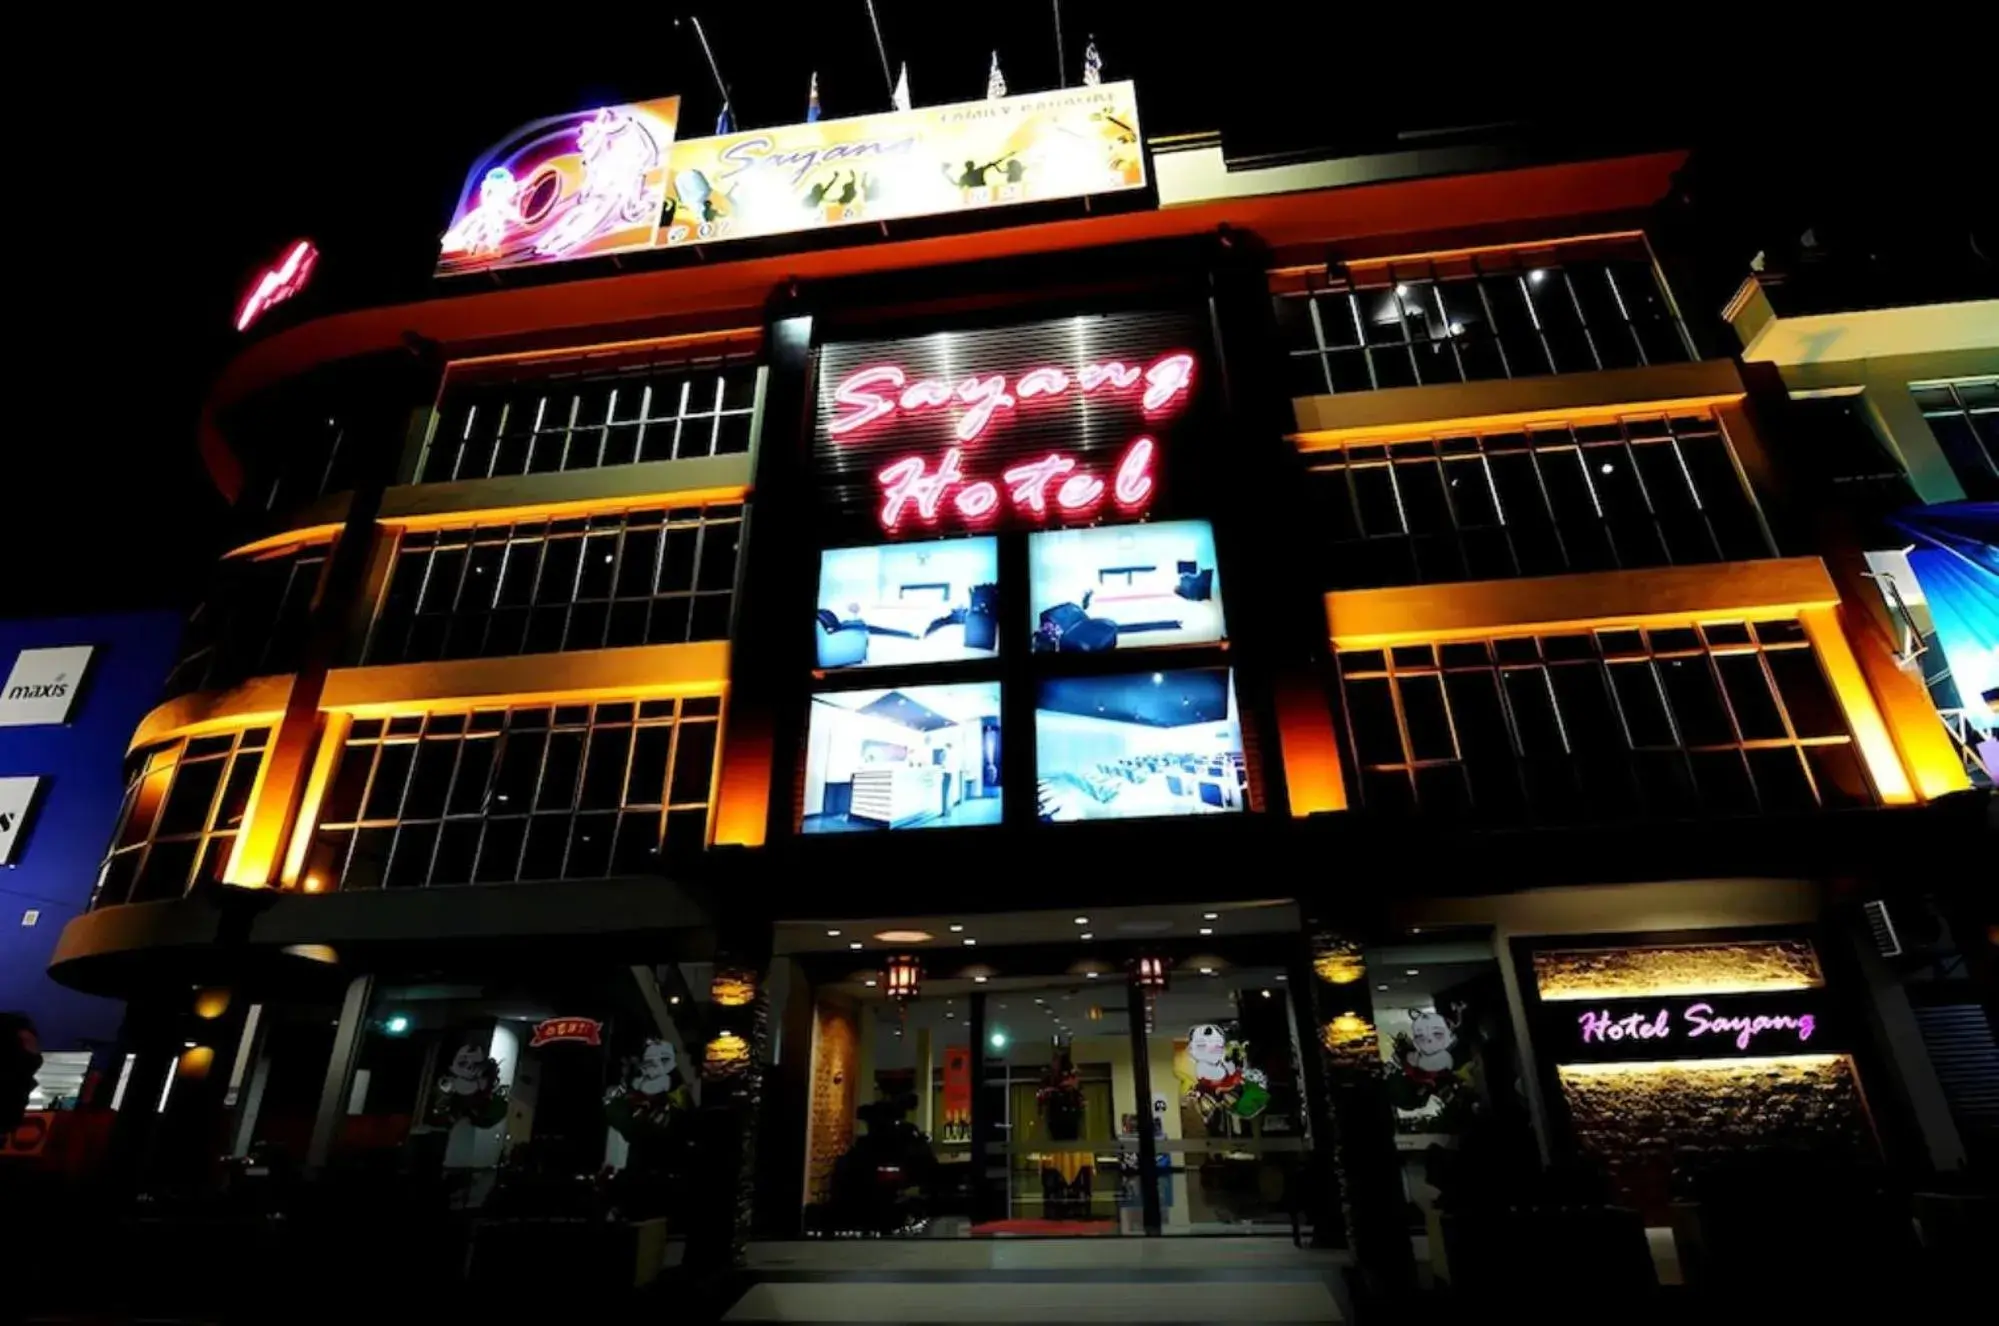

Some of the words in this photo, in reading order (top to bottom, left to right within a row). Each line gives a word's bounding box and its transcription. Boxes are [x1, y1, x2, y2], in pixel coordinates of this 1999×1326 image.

[827, 354, 1195, 441] Sayang
[878, 437, 1154, 528] Hotel
[9, 680, 68, 700] maxis
[1578, 1009, 1669, 1042] Hotel
[1684, 1003, 1815, 1049] Sayang
